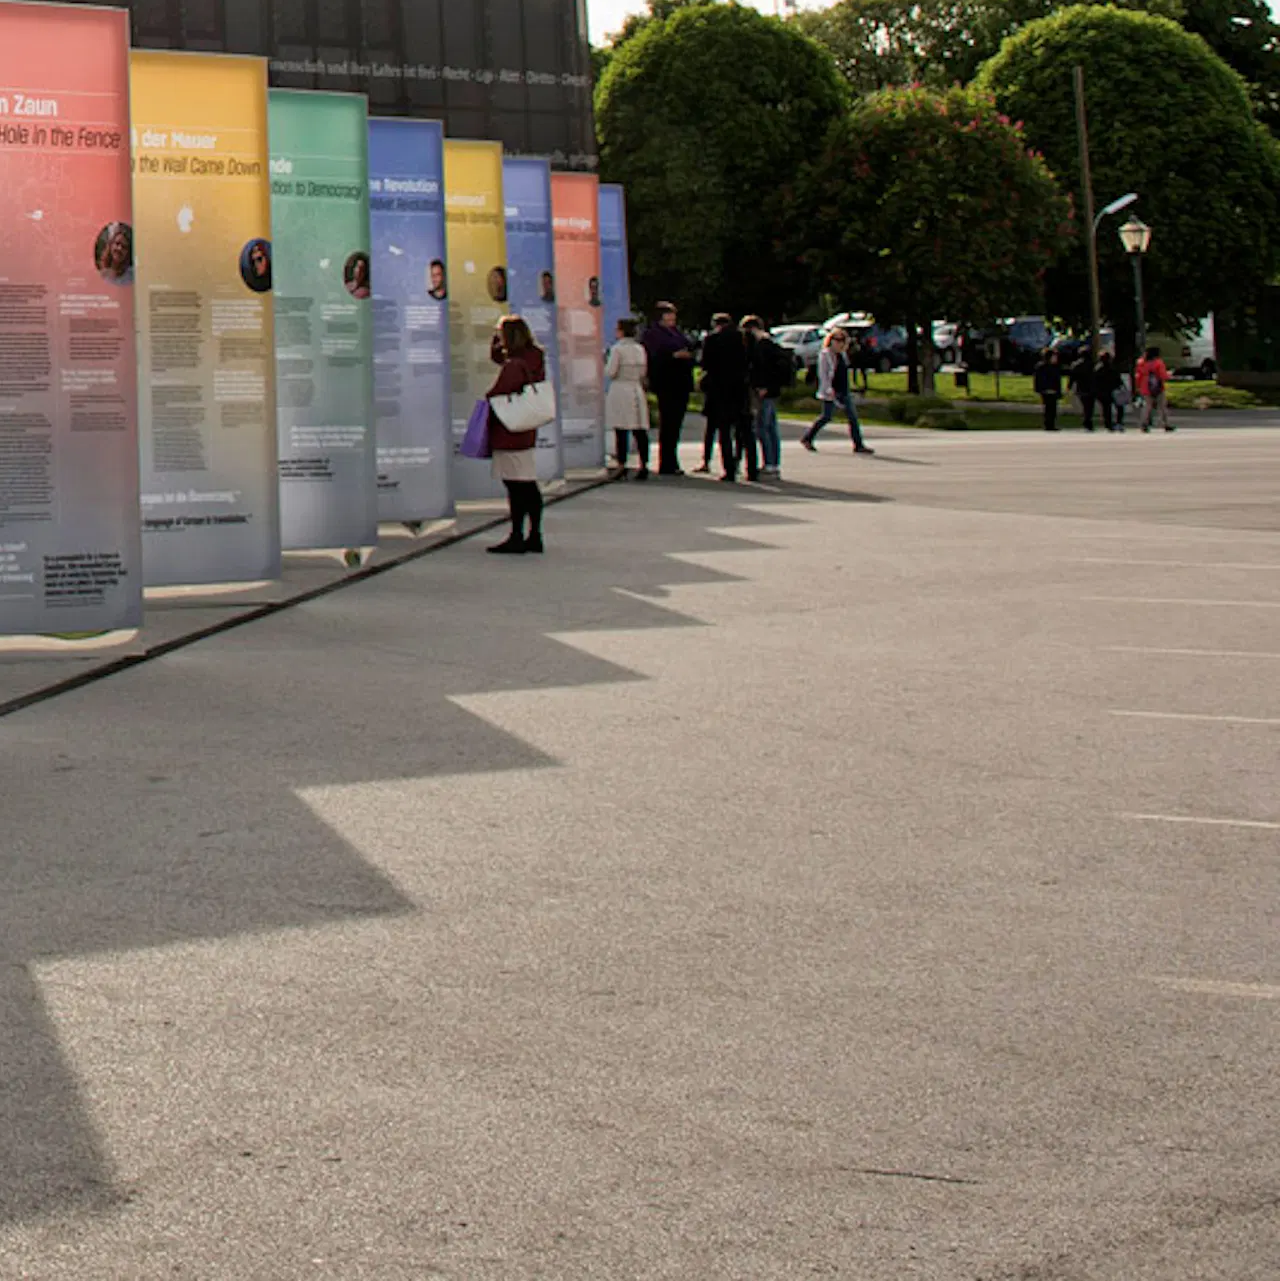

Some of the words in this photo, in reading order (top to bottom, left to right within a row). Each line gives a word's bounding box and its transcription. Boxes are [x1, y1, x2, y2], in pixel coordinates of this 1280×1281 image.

[13, 94, 58, 116] Zaun
[32, 126, 46, 145] in
[51, 127, 73, 146] the
[77, 128, 122, 149] Fence
[142, 130, 167, 147] der
[172, 132, 217, 149] Mauer
[140, 156, 160, 171] the
[191, 158, 224, 176] Came
[228, 158, 261, 176] Down
